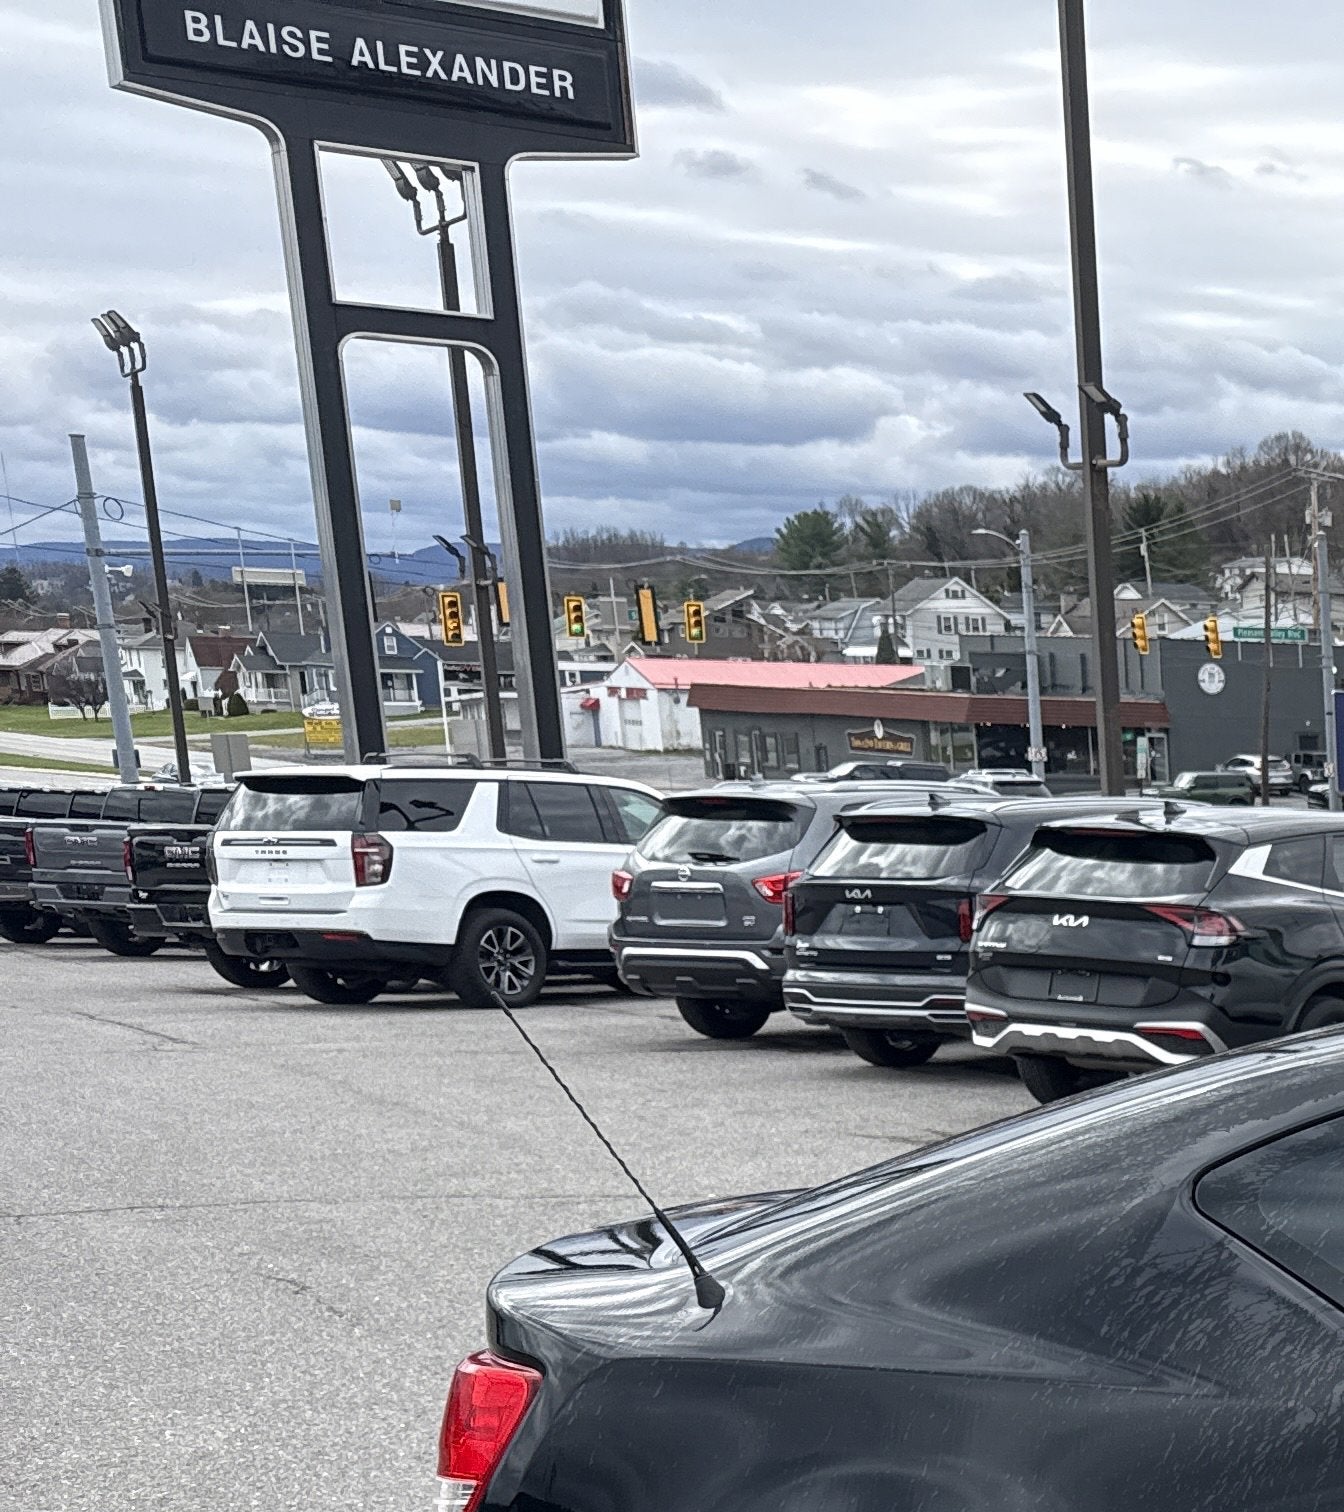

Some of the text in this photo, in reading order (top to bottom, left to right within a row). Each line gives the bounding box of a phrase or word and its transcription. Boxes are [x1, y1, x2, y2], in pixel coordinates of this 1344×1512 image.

[183, 9, 576, 99] BLAISE ALEXANDER
[164, 846, 201, 859] GMC
[844, 888, 873, 899] KIA
[1052, 914, 1090, 928] KIA
